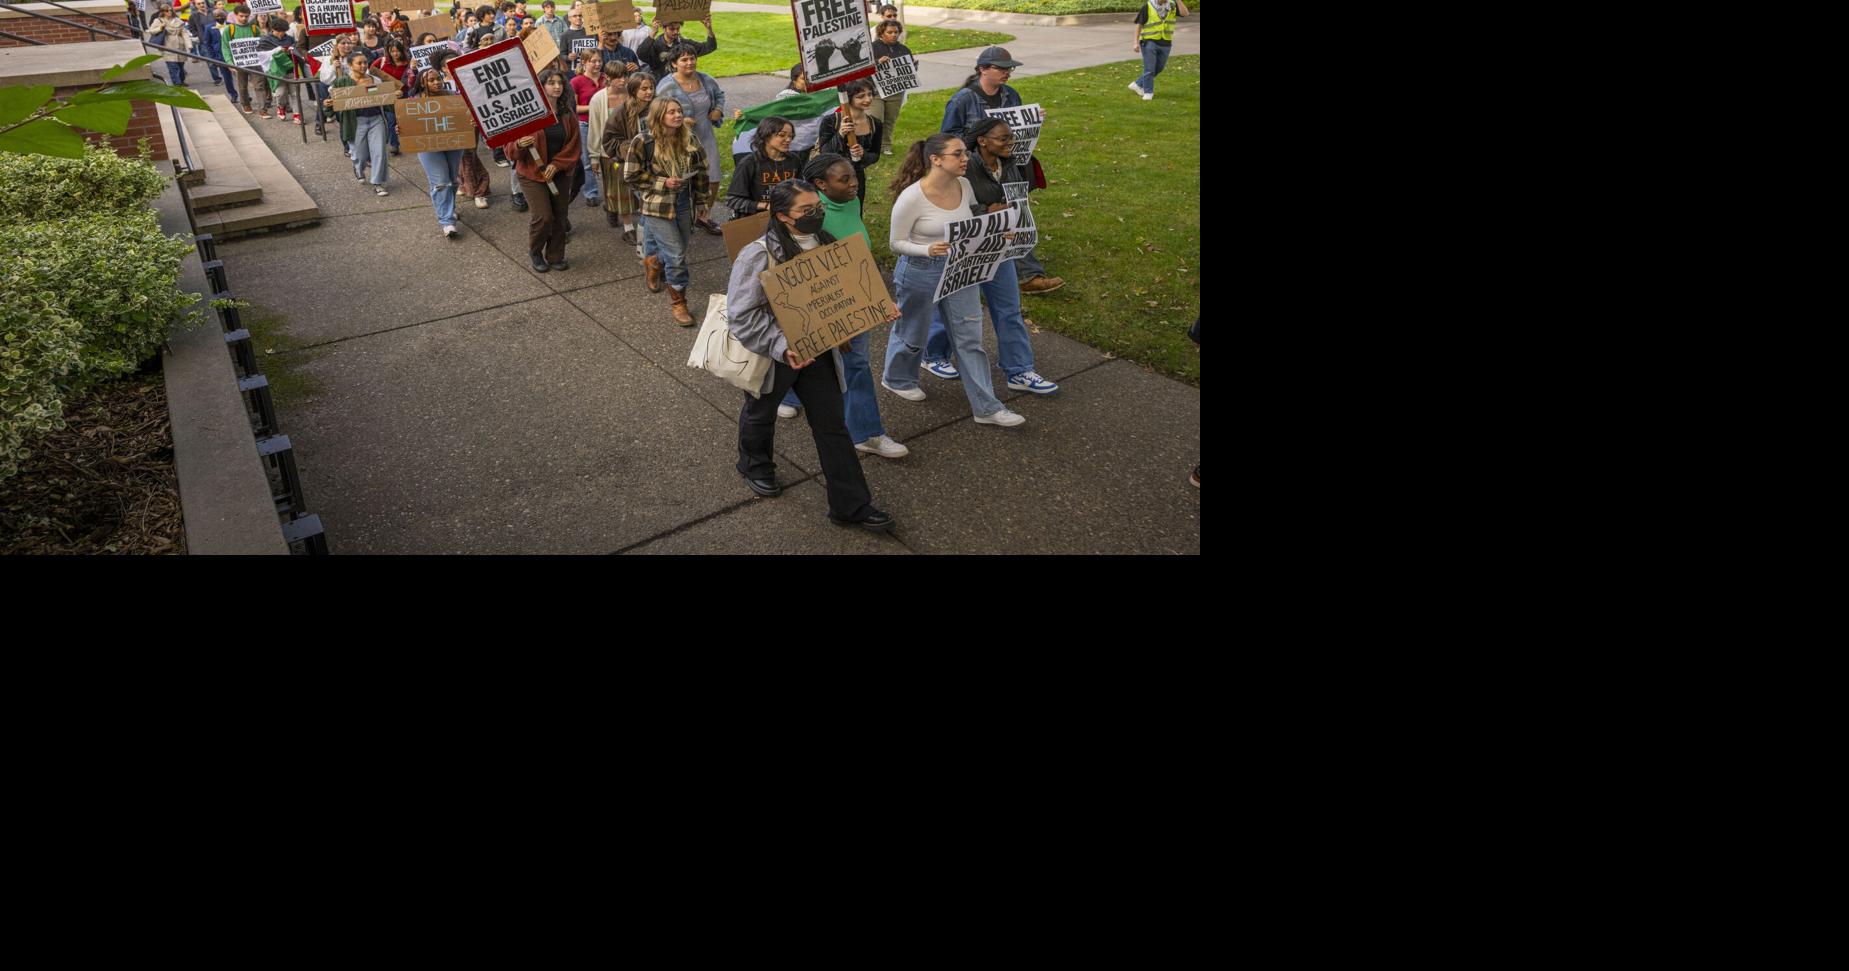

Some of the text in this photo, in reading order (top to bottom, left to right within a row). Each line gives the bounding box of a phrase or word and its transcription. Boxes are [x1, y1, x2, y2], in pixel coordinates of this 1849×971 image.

[308, 4, 349, 13] IS A HUMAN
[309, 11, 351, 25] RIGHT!
[801, 0, 858, 27] FREE
[802, 11, 863, 41] PALESTINE
[472, 57, 511, 84] END
[876, 61, 891, 72] ND
[892, 56, 911, 66] ALL
[896, 65, 913, 77] AID
[484, 75, 517, 99] ALL
[883, 78, 919, 97] ISRAEL!
[405, 100, 441, 115] END
[477, 87, 535, 119] U.S. AID
[482, 117, 499, 130] TO
[499, 100, 540, 124] ISRAEL!
[416, 115, 456, 133] THE
[1021, 107, 1041, 125] ALL
[949, 210, 1011, 244] END ALL
[974, 233, 1007, 254] AID
[944, 265, 954, 280] TO
[953, 252, 1001, 273] APARTHEID
[810, 274, 840, 295] AGAINST
[940, 263, 993, 299] ISRAEL!
[806, 288, 845, 313] IMPERIALIST
[819, 295, 857, 320] OCCUPATION
[794, 298, 889, 361] FREE PALESTINE
